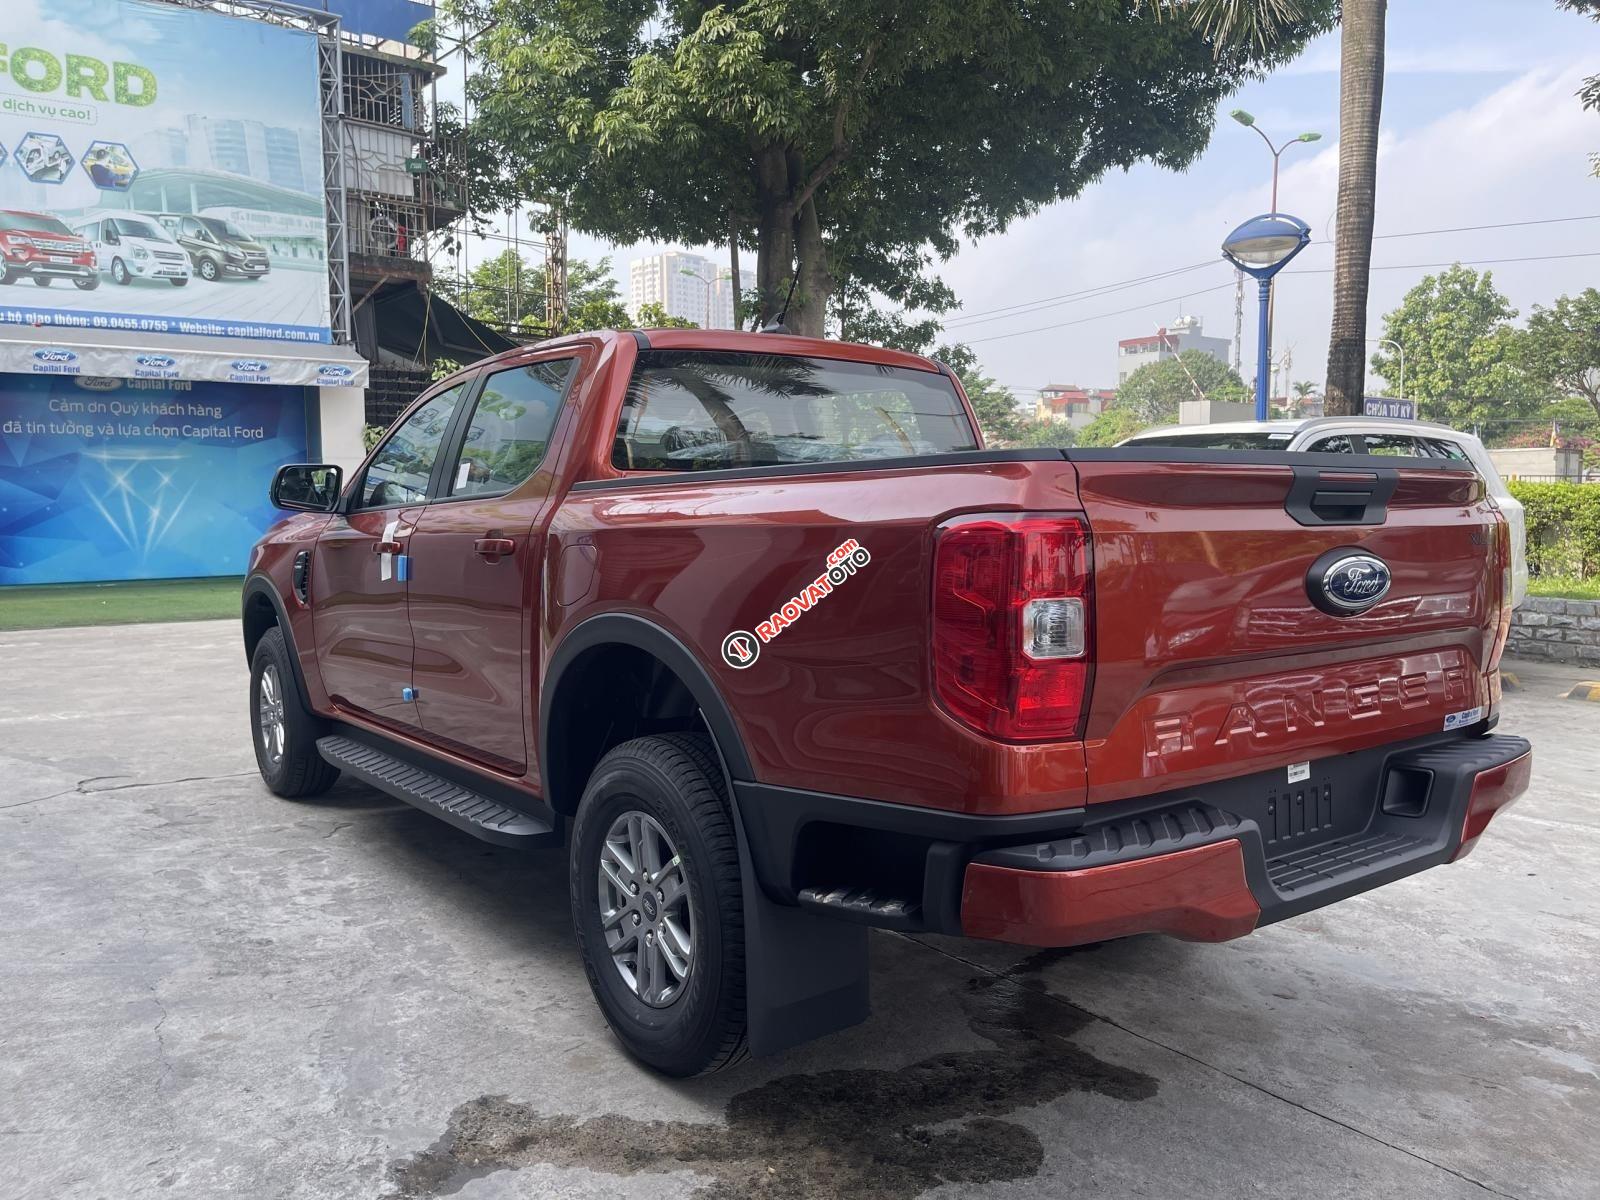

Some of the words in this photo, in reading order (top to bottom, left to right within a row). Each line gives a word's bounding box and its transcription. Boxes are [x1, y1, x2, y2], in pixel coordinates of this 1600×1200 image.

[0, 42, 157, 107] ORD
[3, 99, 35, 113] dịch
[38, 104, 56, 117] vụ
[60, 107, 91, 120] cao!
[7, 310, 22, 325] hộ
[26, 312, 52, 325] giao
[54, 312, 90, 328] thông:
[93, 315, 169, 332] 09.0455.0755
[179, 321, 225, 336] Website:
[227, 325, 320, 342] capitalford.com.vn
[32, 363, 61, 374] Capital
[63, 364, 81, 374] Ford
[134, 369, 162, 378] Capital
[163, 370, 180, 379] Ford
[229, 373, 256, 382] Capital
[256, 374, 271, 383] Ford
[126, 378, 166, 391] Capital
[168, 379, 192, 392] Ford
[48, 398, 84, 412] Cảm
[87, 401, 107, 413] ơn
[110, 401, 140, 417] Quý
[142, 401, 185, 415] khách
[187, 403, 223, 419] hàng
[2, 420, 22, 434] đã
[25, 421, 46, 434] tin
[49, 419, 95, 437] tưởng
[97, 421, 115, 435] và
[118, 423, 141, 439] lựa
[144, 424, 179, 439] chọn
[181, 424, 231, 440] Capital
[233, 426, 264, 439] Ford
[1343, 567, 1380, 595] Ford
[1143, 662, 1466, 758] RANGER
